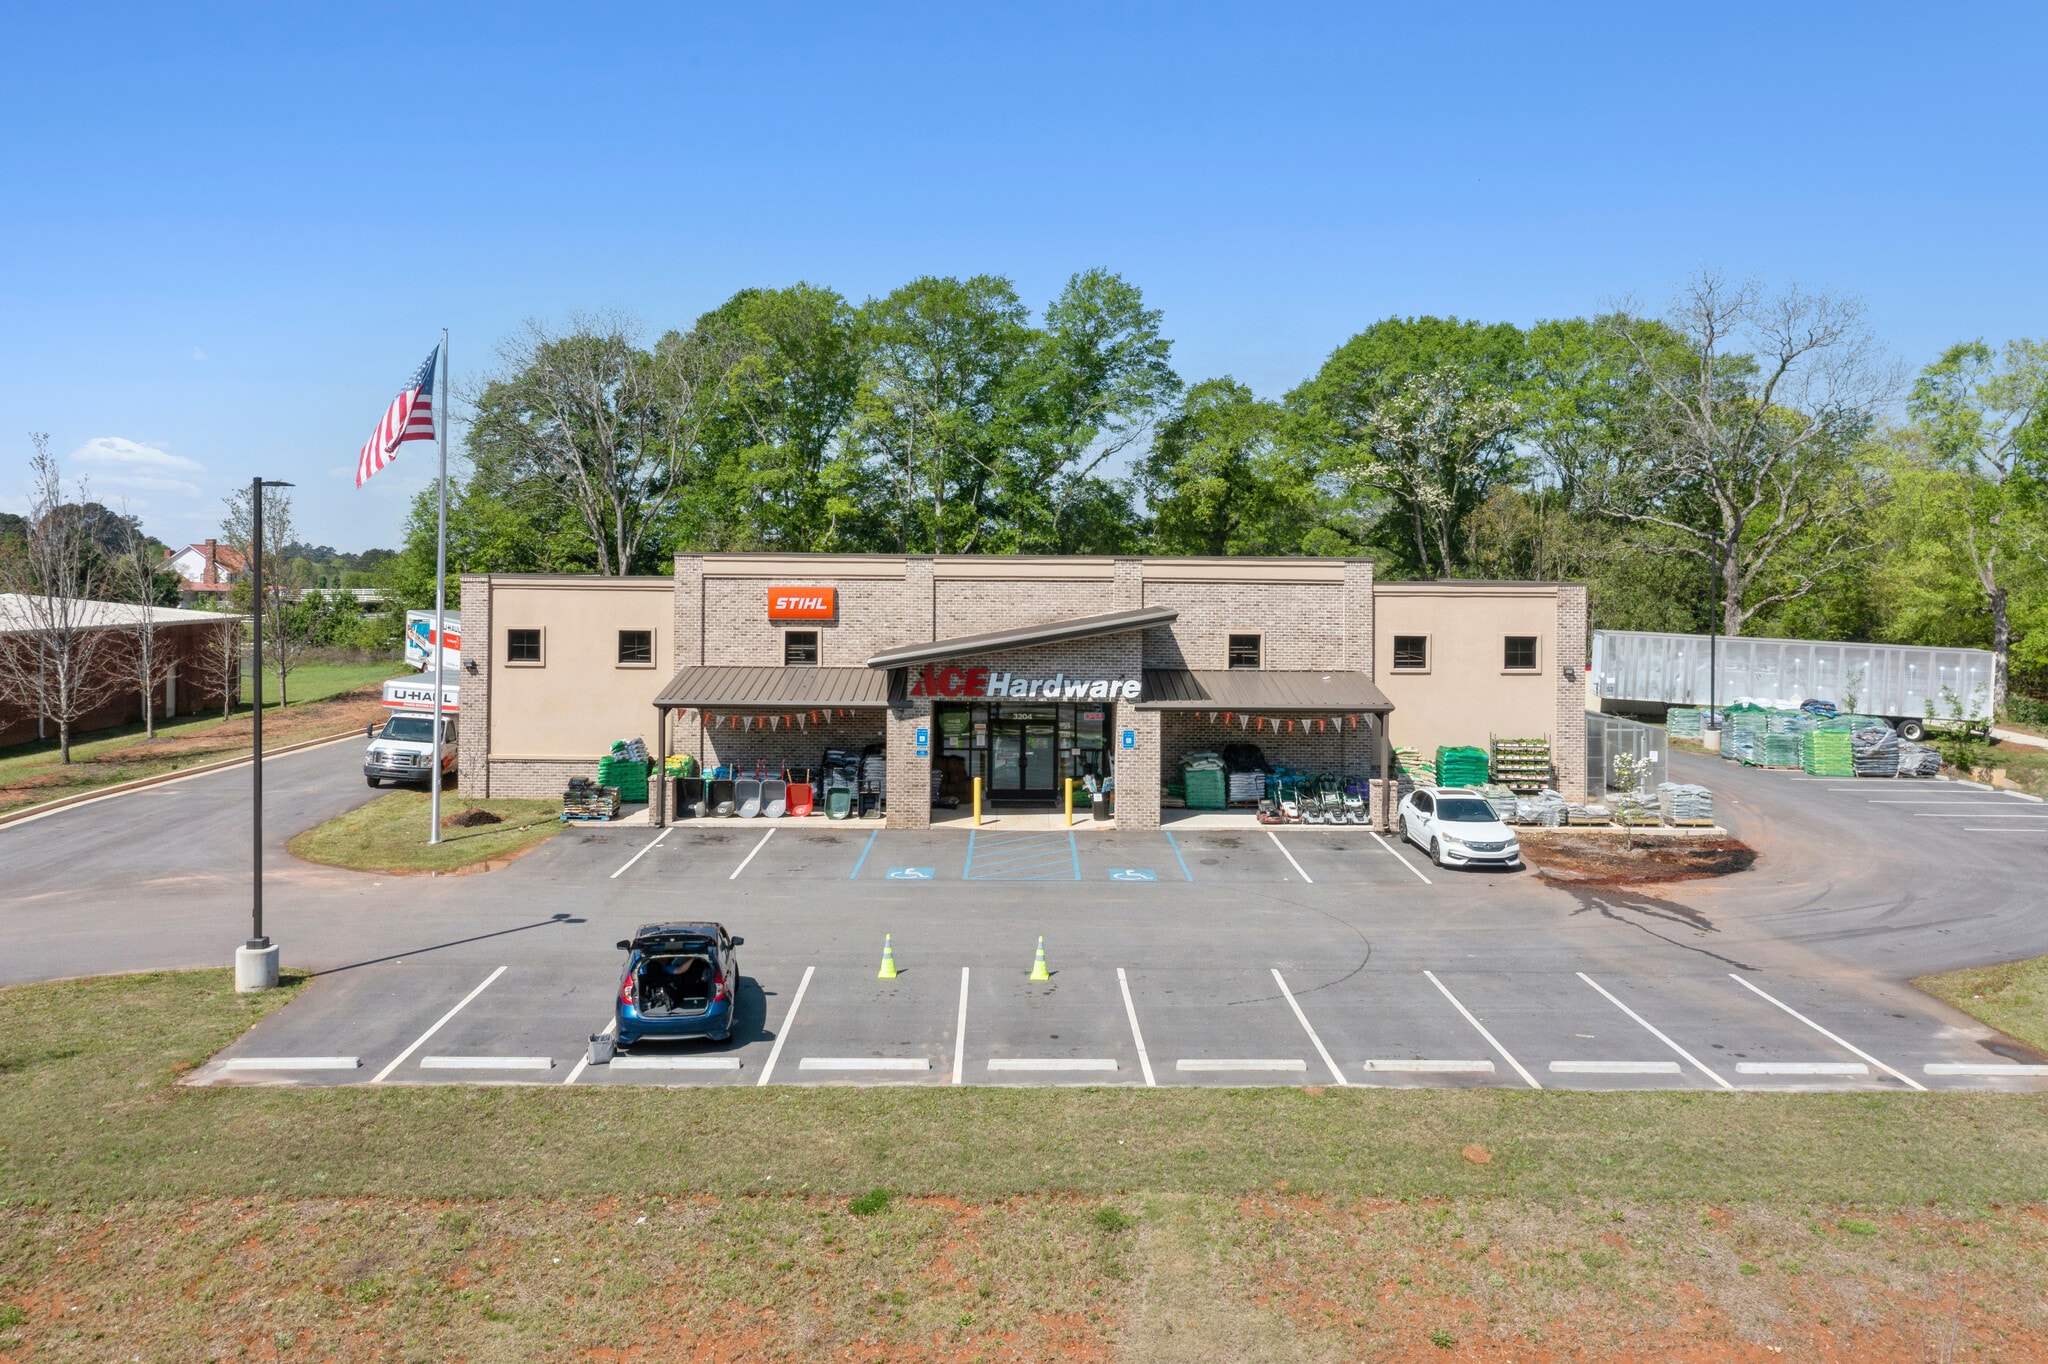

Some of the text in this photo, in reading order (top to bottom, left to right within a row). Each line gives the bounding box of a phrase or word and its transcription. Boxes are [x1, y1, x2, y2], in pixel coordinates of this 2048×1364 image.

[775, 597, 827, 610] STIHL
[909, 665, 1141, 698] ACE Hardware
[394, 690, 451, 702] U-HAL
